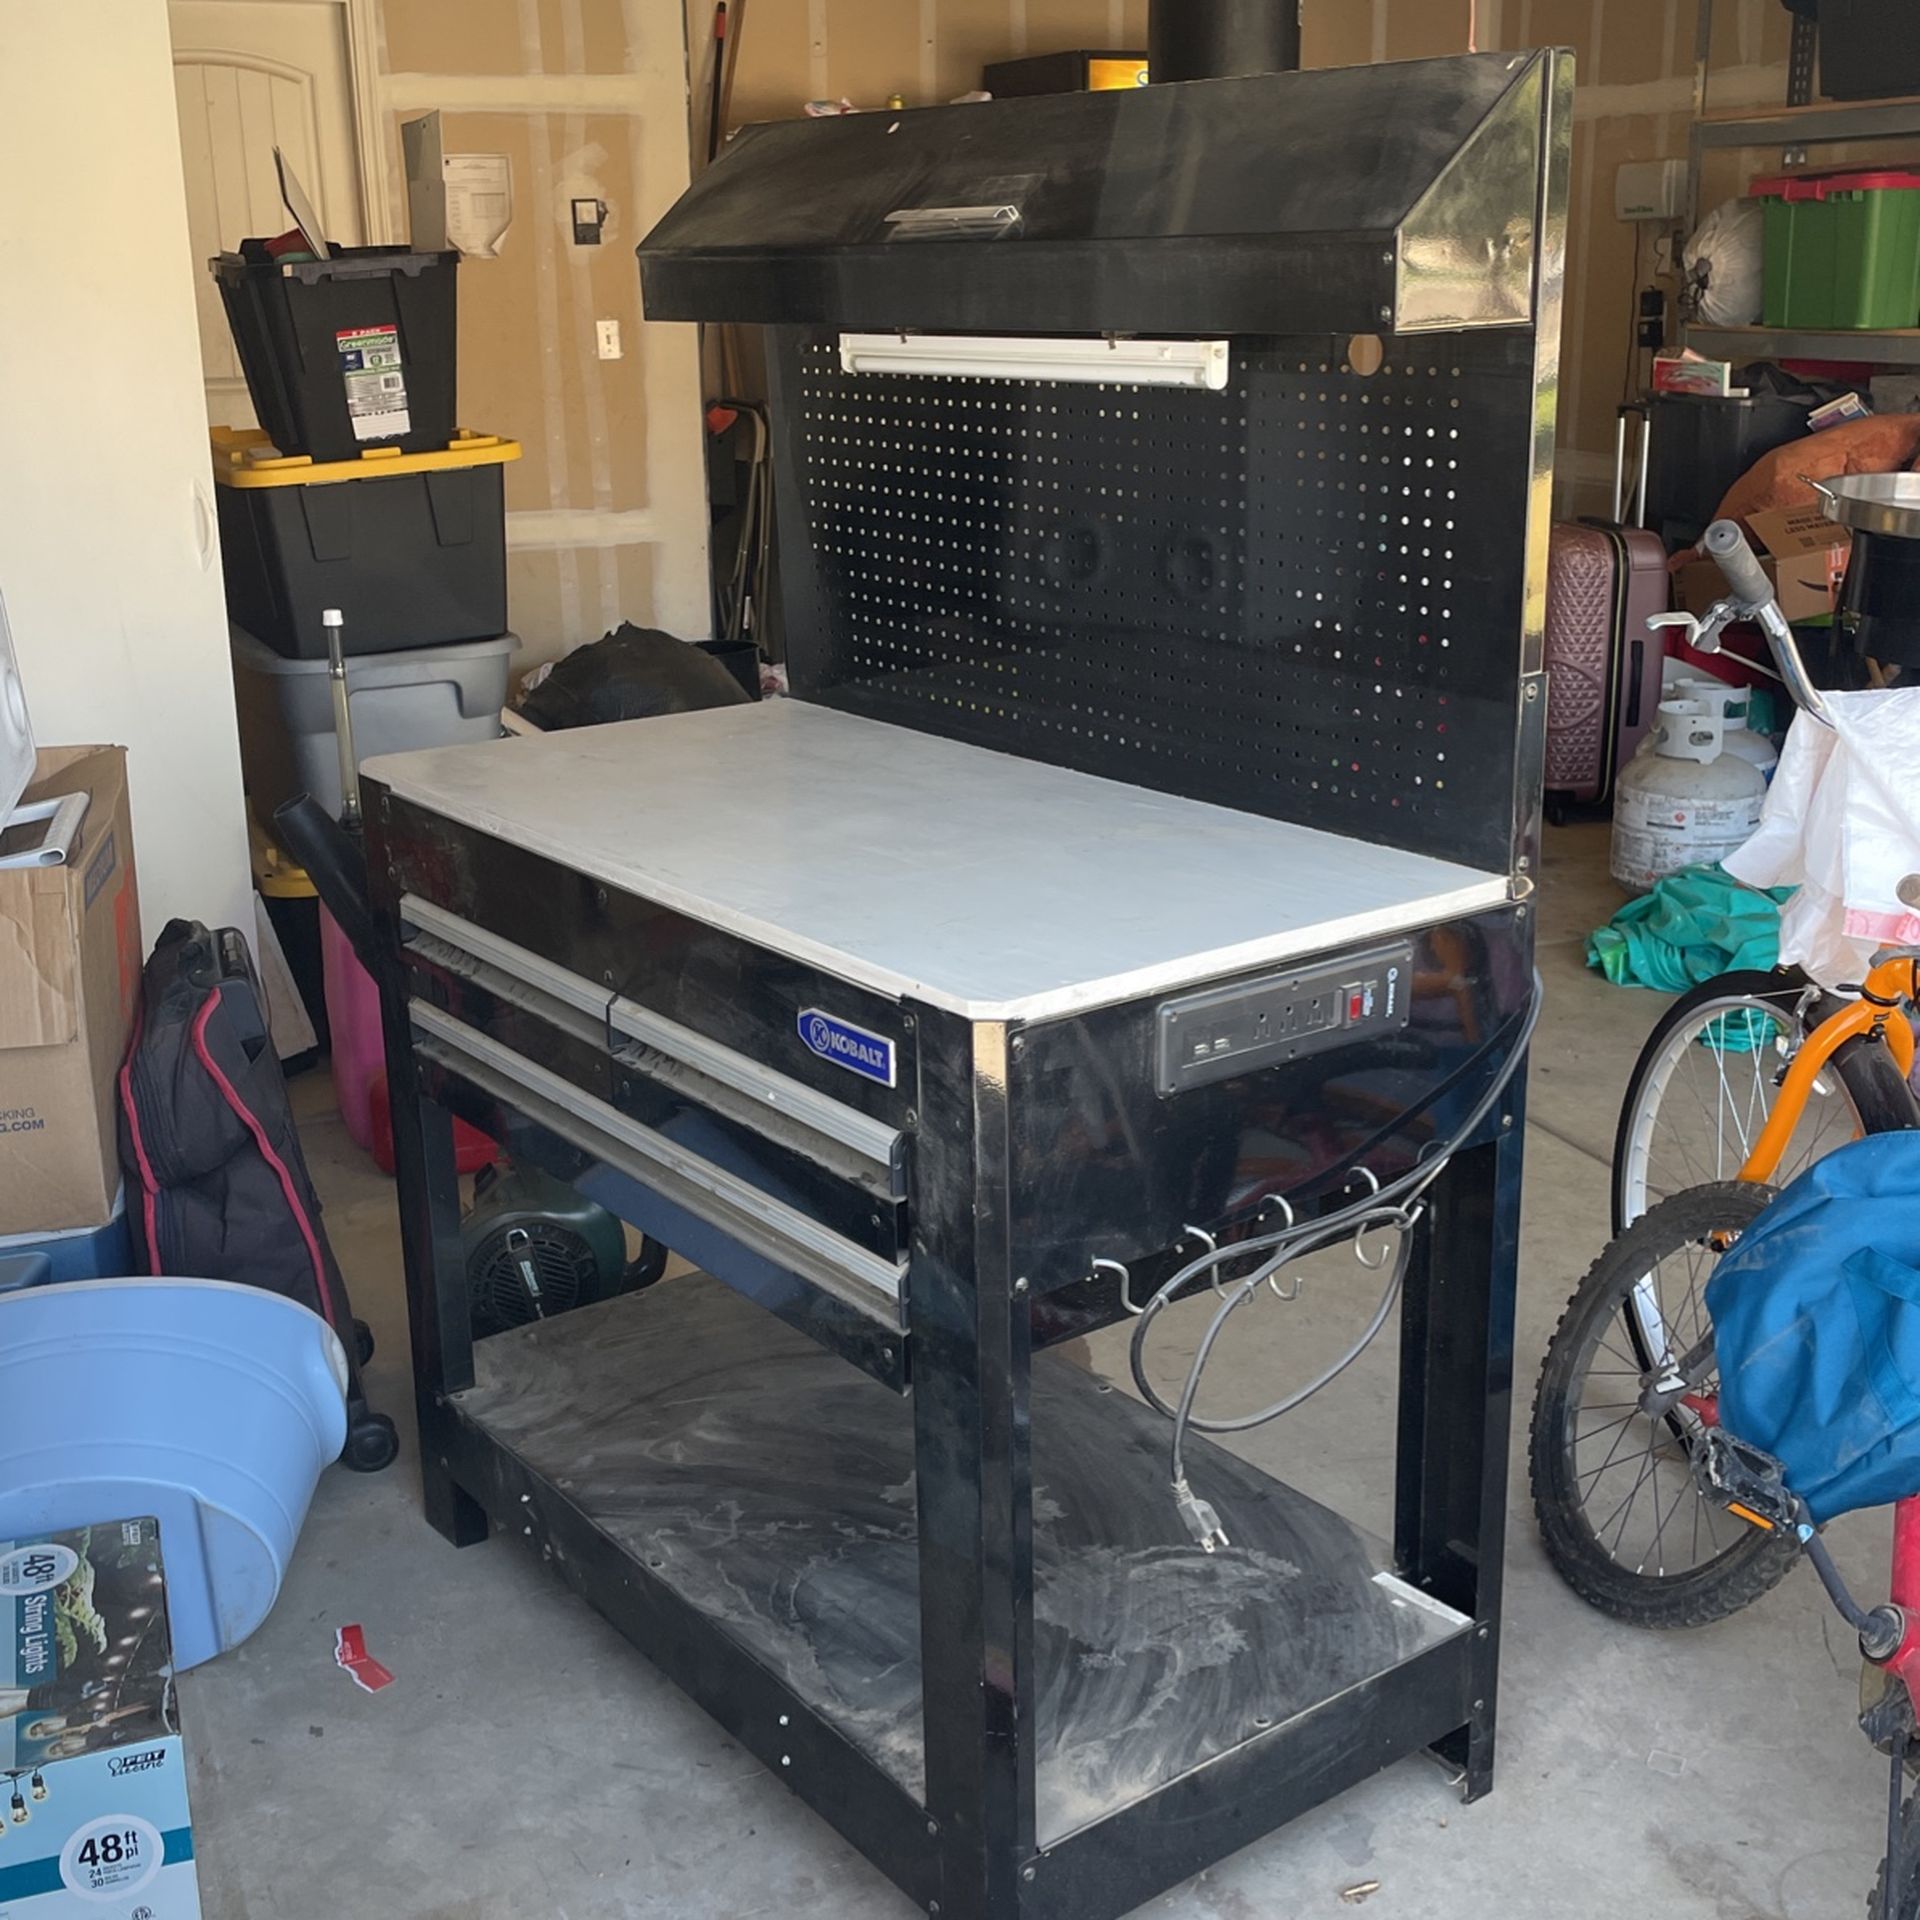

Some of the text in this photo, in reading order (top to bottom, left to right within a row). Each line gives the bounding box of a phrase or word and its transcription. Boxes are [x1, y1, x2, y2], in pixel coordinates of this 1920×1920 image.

[831, 1032, 883, 1068] KOBALT
[0, 1107, 35, 1119] KING
[23, 1554, 55, 1577] 48
[20, 1595, 48, 1674] String Lights
[78, 1830, 138, 1867] 48 ft
[125, 1843, 139, 1860] pi
[88, 1867, 102, 1879] 24
[91, 1877, 104, 1889] 30
